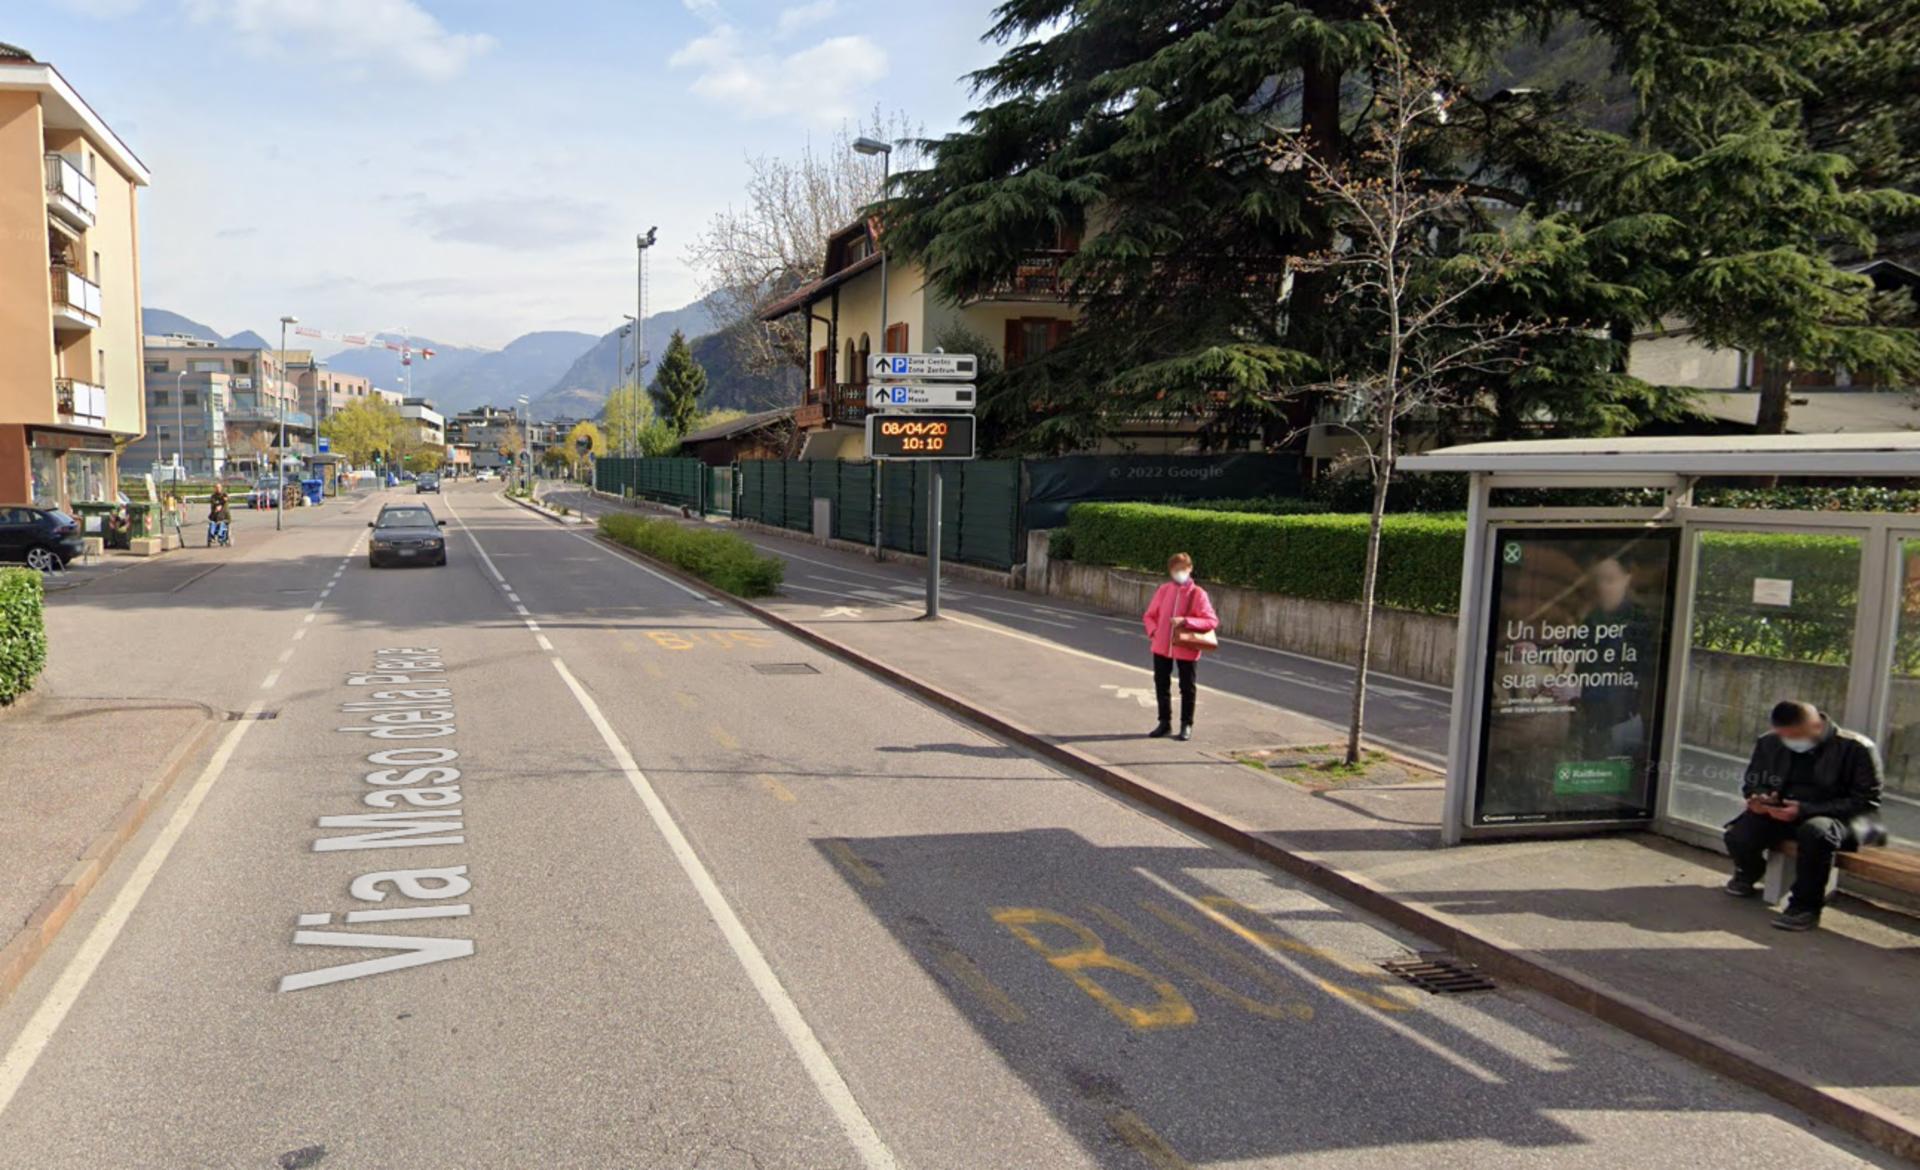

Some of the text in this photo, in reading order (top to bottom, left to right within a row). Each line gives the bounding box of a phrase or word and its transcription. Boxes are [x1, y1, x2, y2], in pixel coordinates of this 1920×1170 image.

[882, 422, 948, 435] 08/04/20
[902, 437, 943, 450] 10:10
[1507, 620, 1627, 644] Un bene per
[1504, 642, 1638, 664] il territorio e la
[1502, 674, 1537, 689] sua
